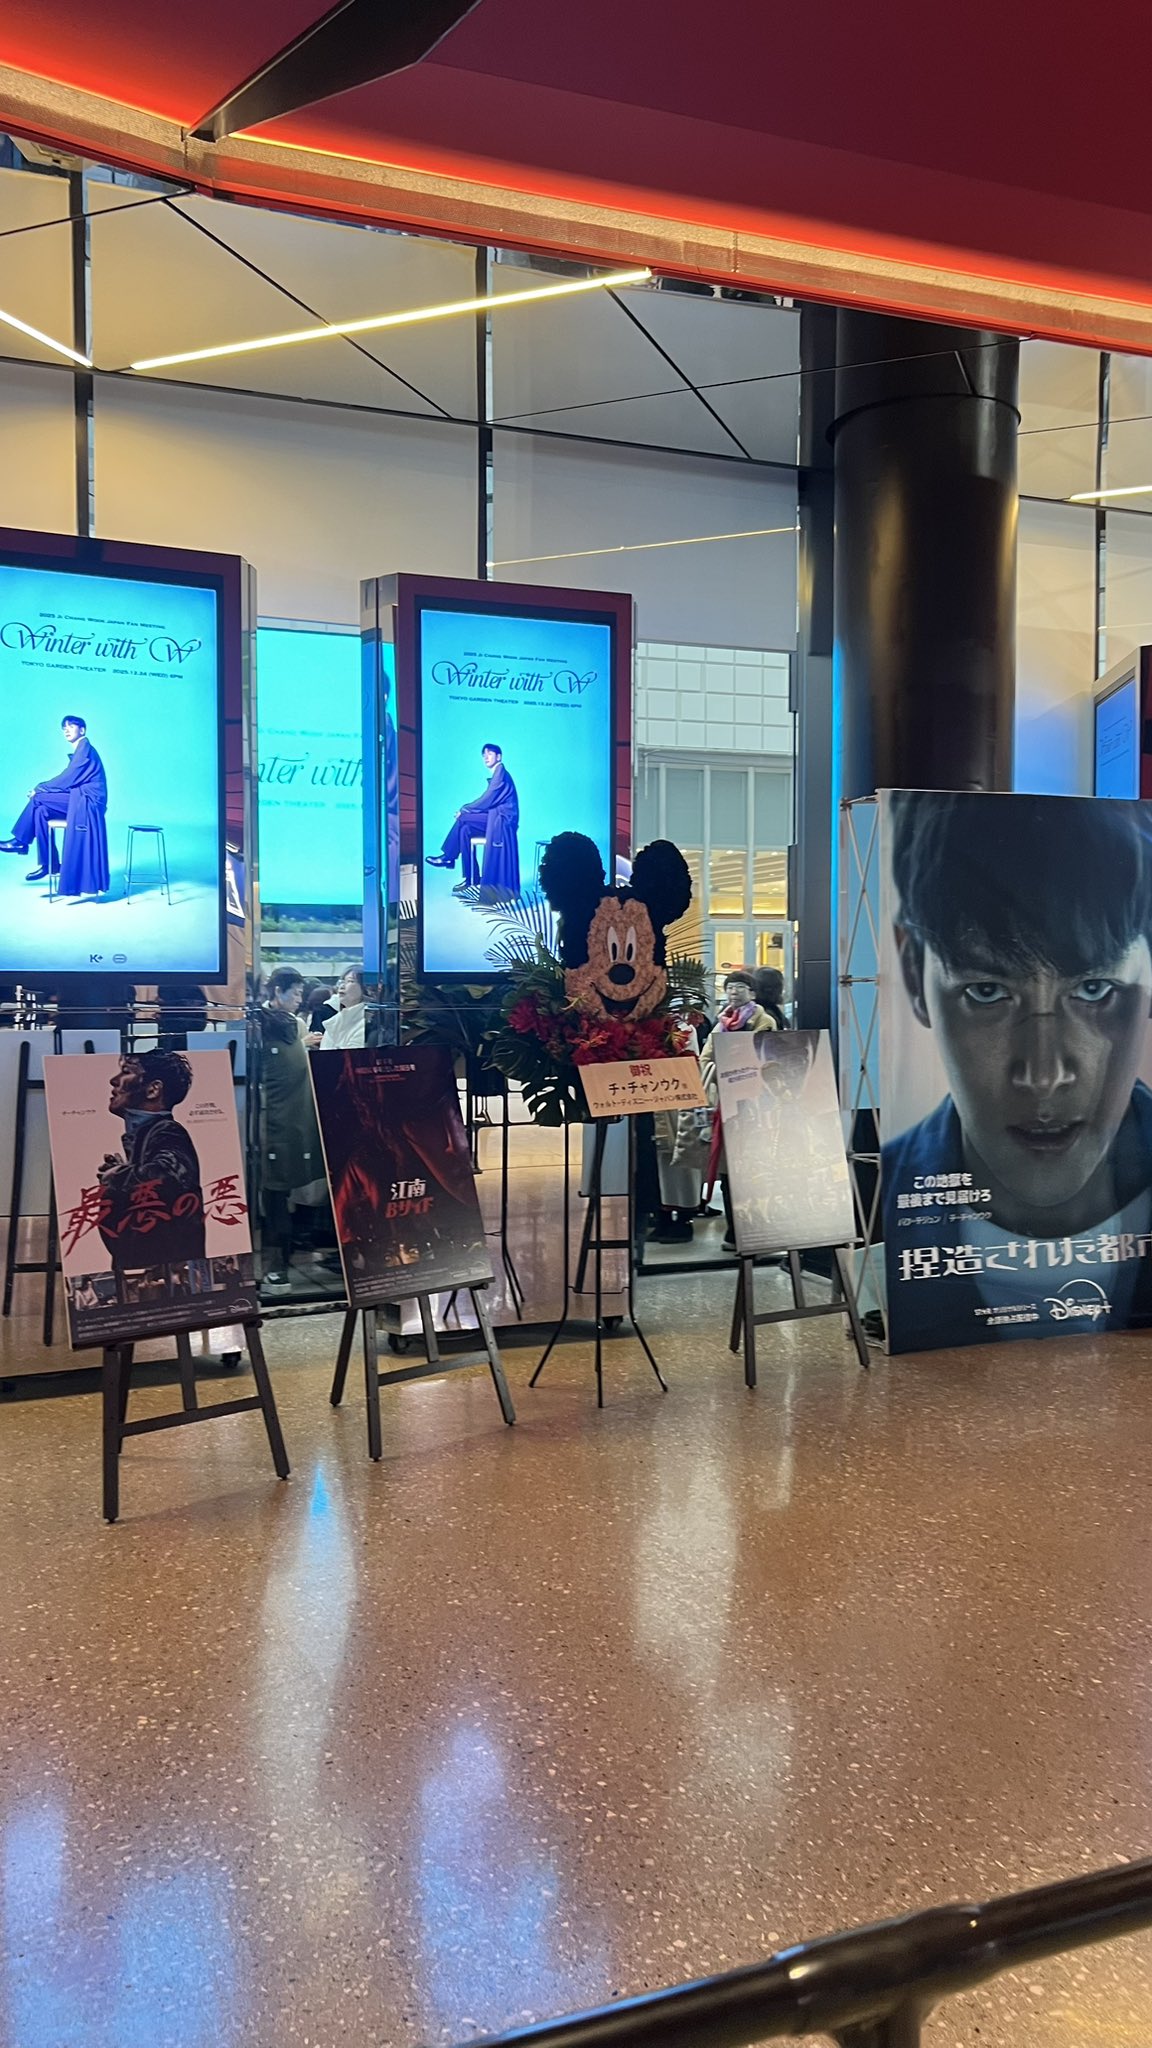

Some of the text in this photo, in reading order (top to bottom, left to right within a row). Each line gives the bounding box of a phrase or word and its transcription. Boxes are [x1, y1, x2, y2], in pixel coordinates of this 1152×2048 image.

[0, 621, 202, 664] Winter with W
[21, 660, 45, 668] TOKYO
[46, 662, 74, 670] GARDEN
[75, 665, 107, 673] THEATER
[431, 660, 598, 695] Winter with W
[629, 1063, 653, 1078] 御祝
[390, 1178, 427, 1201] 江南
[912, 1172, 974, 1190] この地獄を
[897, 1188, 993, 1209] 最後まで見届けろ
[58, 1174, 248, 1257] 最悪の悪
